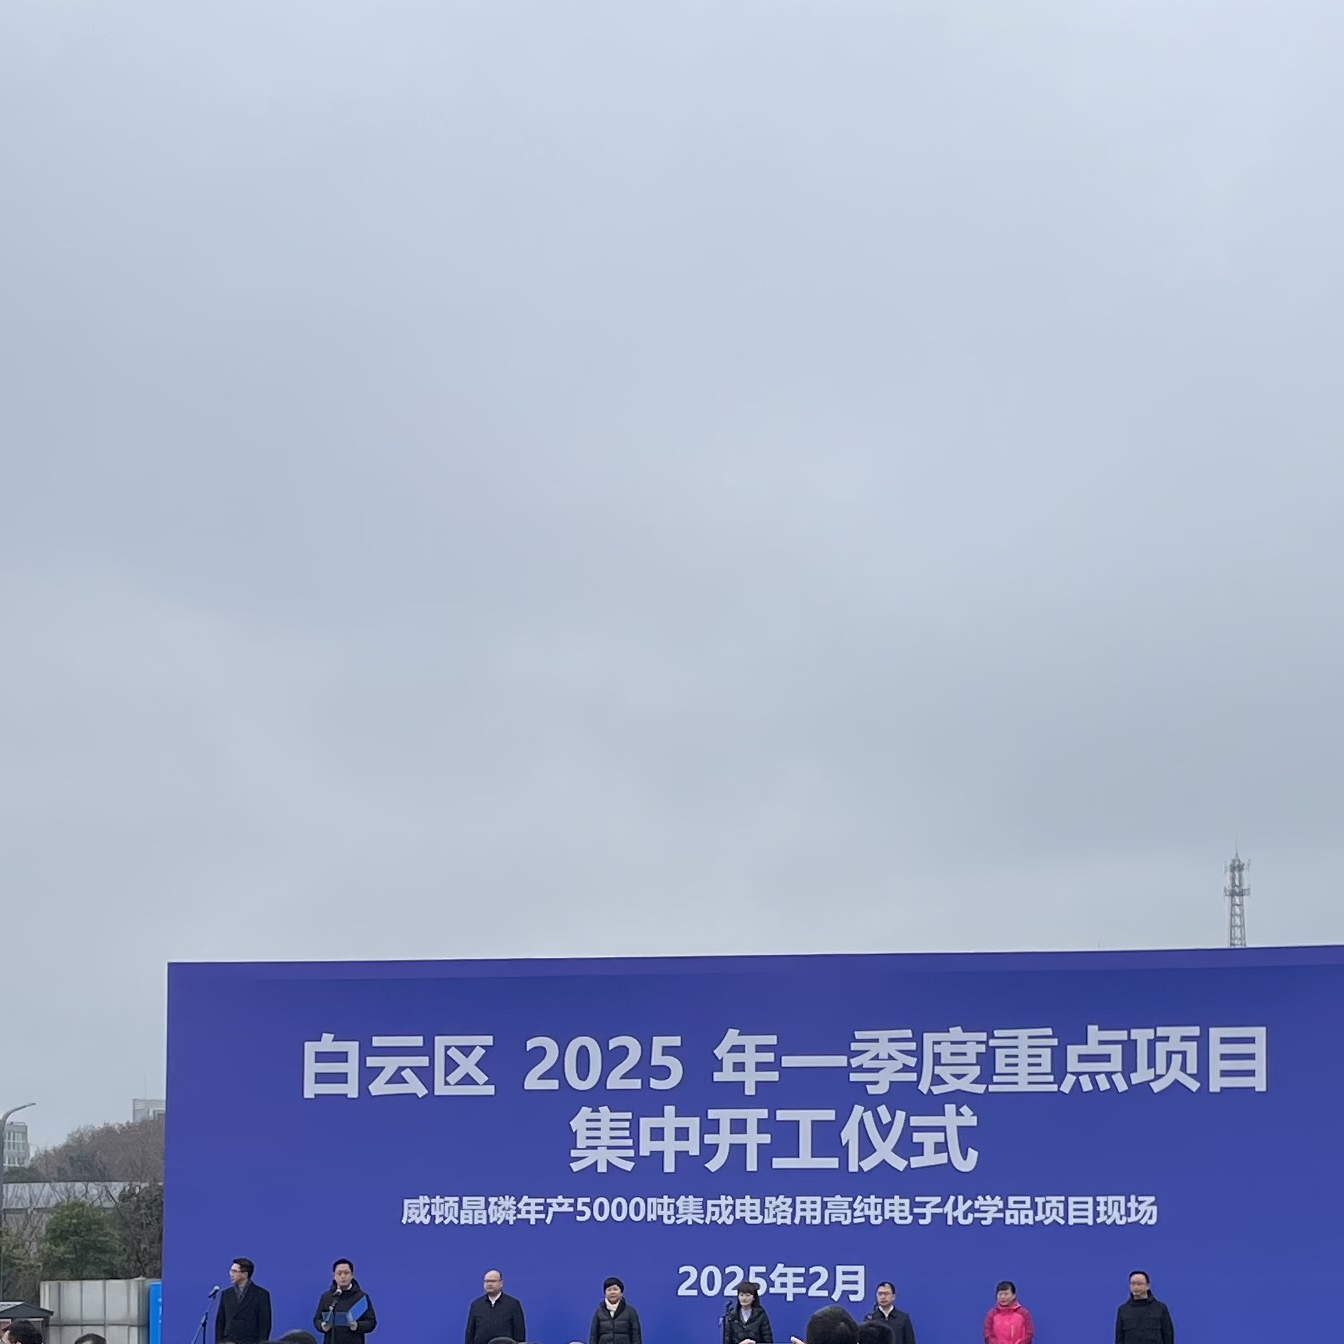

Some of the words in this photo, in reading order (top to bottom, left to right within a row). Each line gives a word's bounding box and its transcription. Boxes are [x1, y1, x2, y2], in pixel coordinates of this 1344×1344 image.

[303, 1033, 495, 1099] 白云区
[523, 1035, 684, 1091] 2025
[713, 1025, 1267, 1096] 年一季度重点项目
[569, 1104, 979, 1173] 集中开工仪式
[401, 1195, 1158, 1226] 威顿晶磷年产5000吨集成电路用高纯电子化学品项目现场
[677, 1263, 865, 1302] 2025年2月
